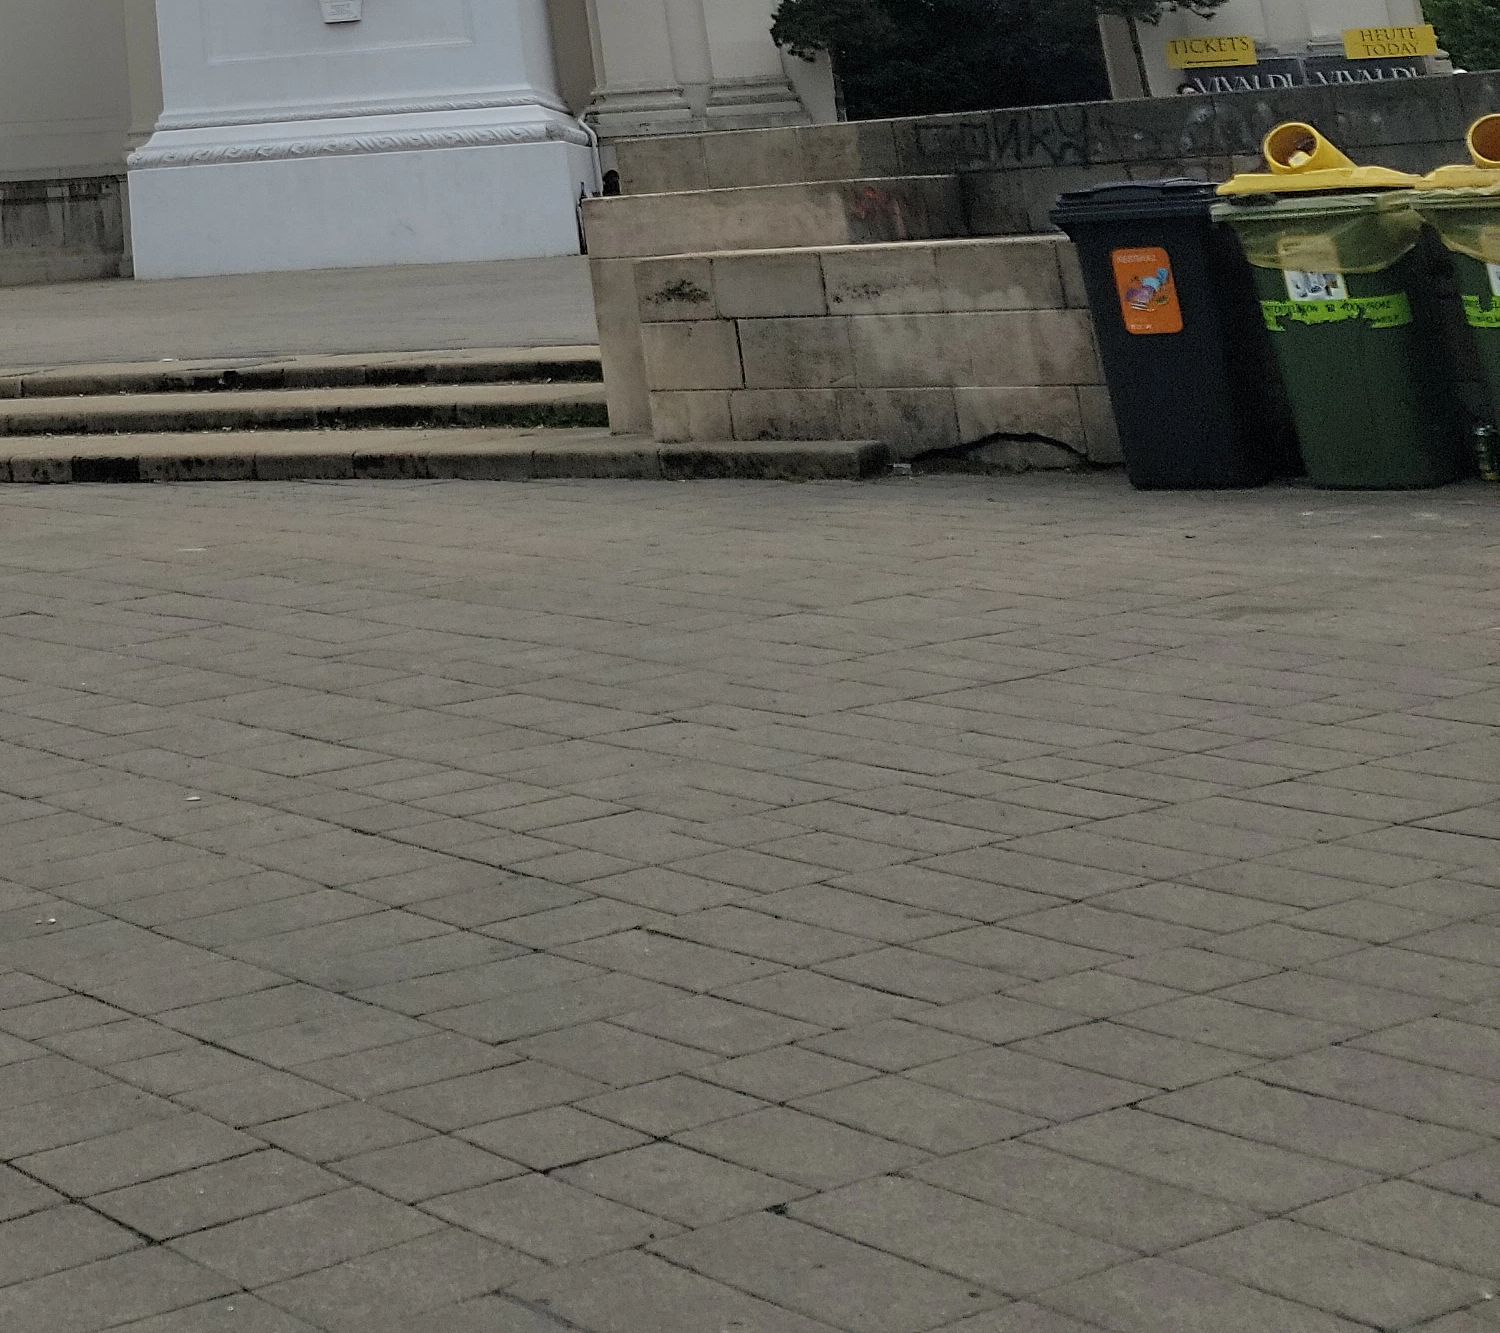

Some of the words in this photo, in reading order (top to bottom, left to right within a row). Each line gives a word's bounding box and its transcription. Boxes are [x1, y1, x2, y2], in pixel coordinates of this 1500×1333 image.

[1361, 28, 1415, 42] HEUTE
[1170, 37, 1249, 54] TICKETS
[1363, 42, 1418, 56] TODAY
